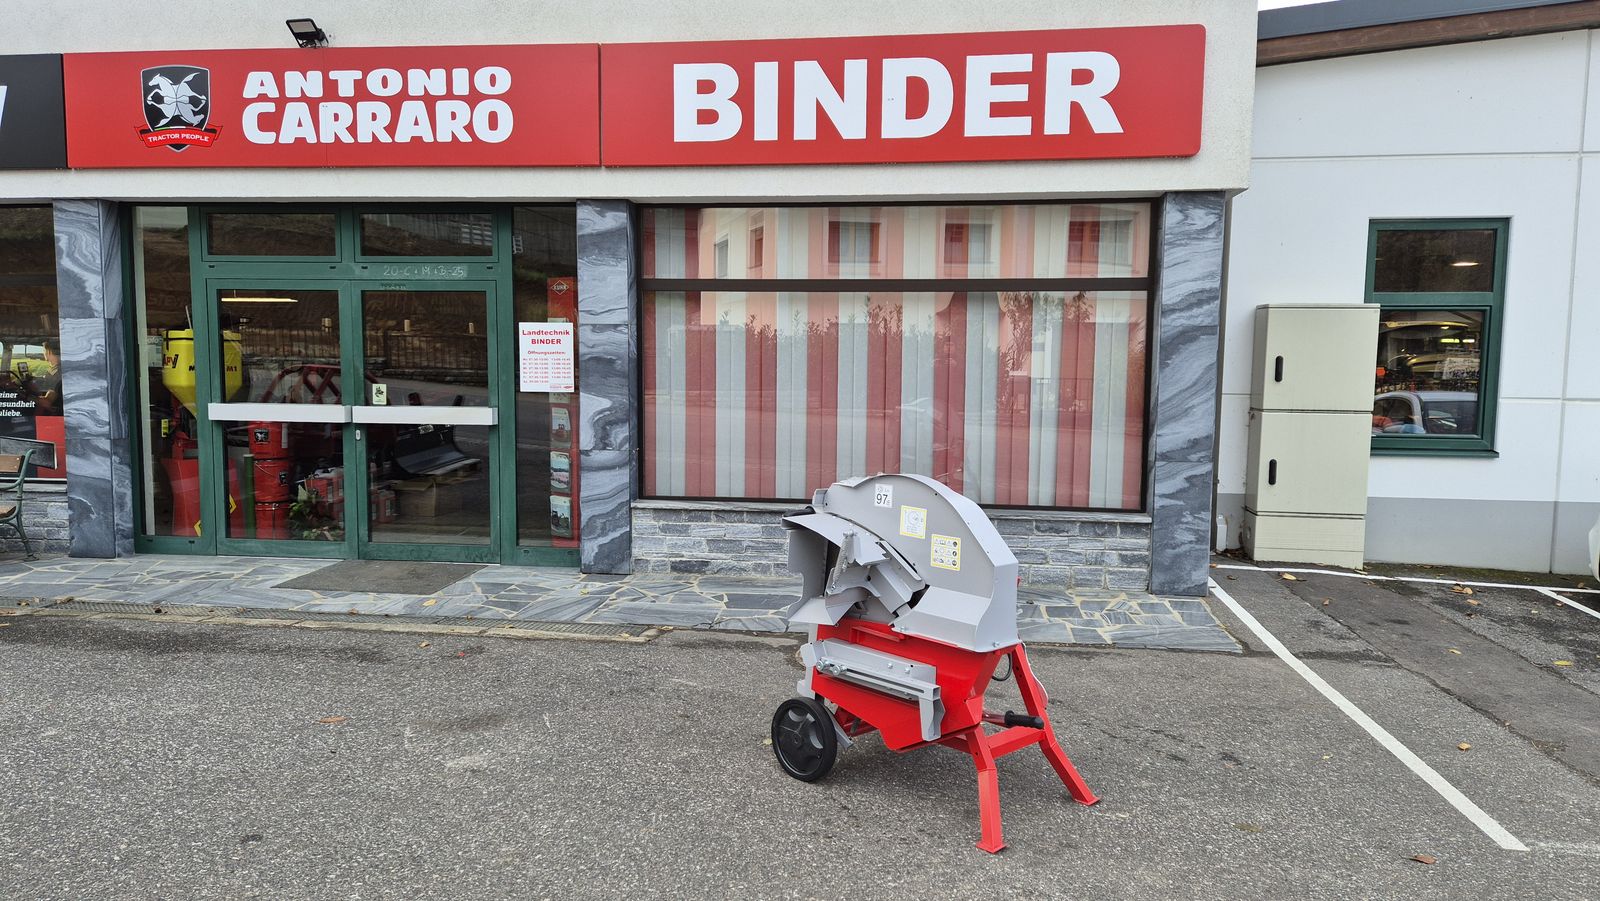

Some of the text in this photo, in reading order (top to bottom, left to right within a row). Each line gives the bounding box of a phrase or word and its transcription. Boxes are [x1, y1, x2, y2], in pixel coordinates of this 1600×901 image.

[242, 66, 512, 99] ANTONIO
[673, 51, 1124, 143] BINDER
[242, 98, 514, 144] CARRARO
[148, 134, 209, 142] TRACTOR PEOPLE
[876, 493, 888, 504] 97
